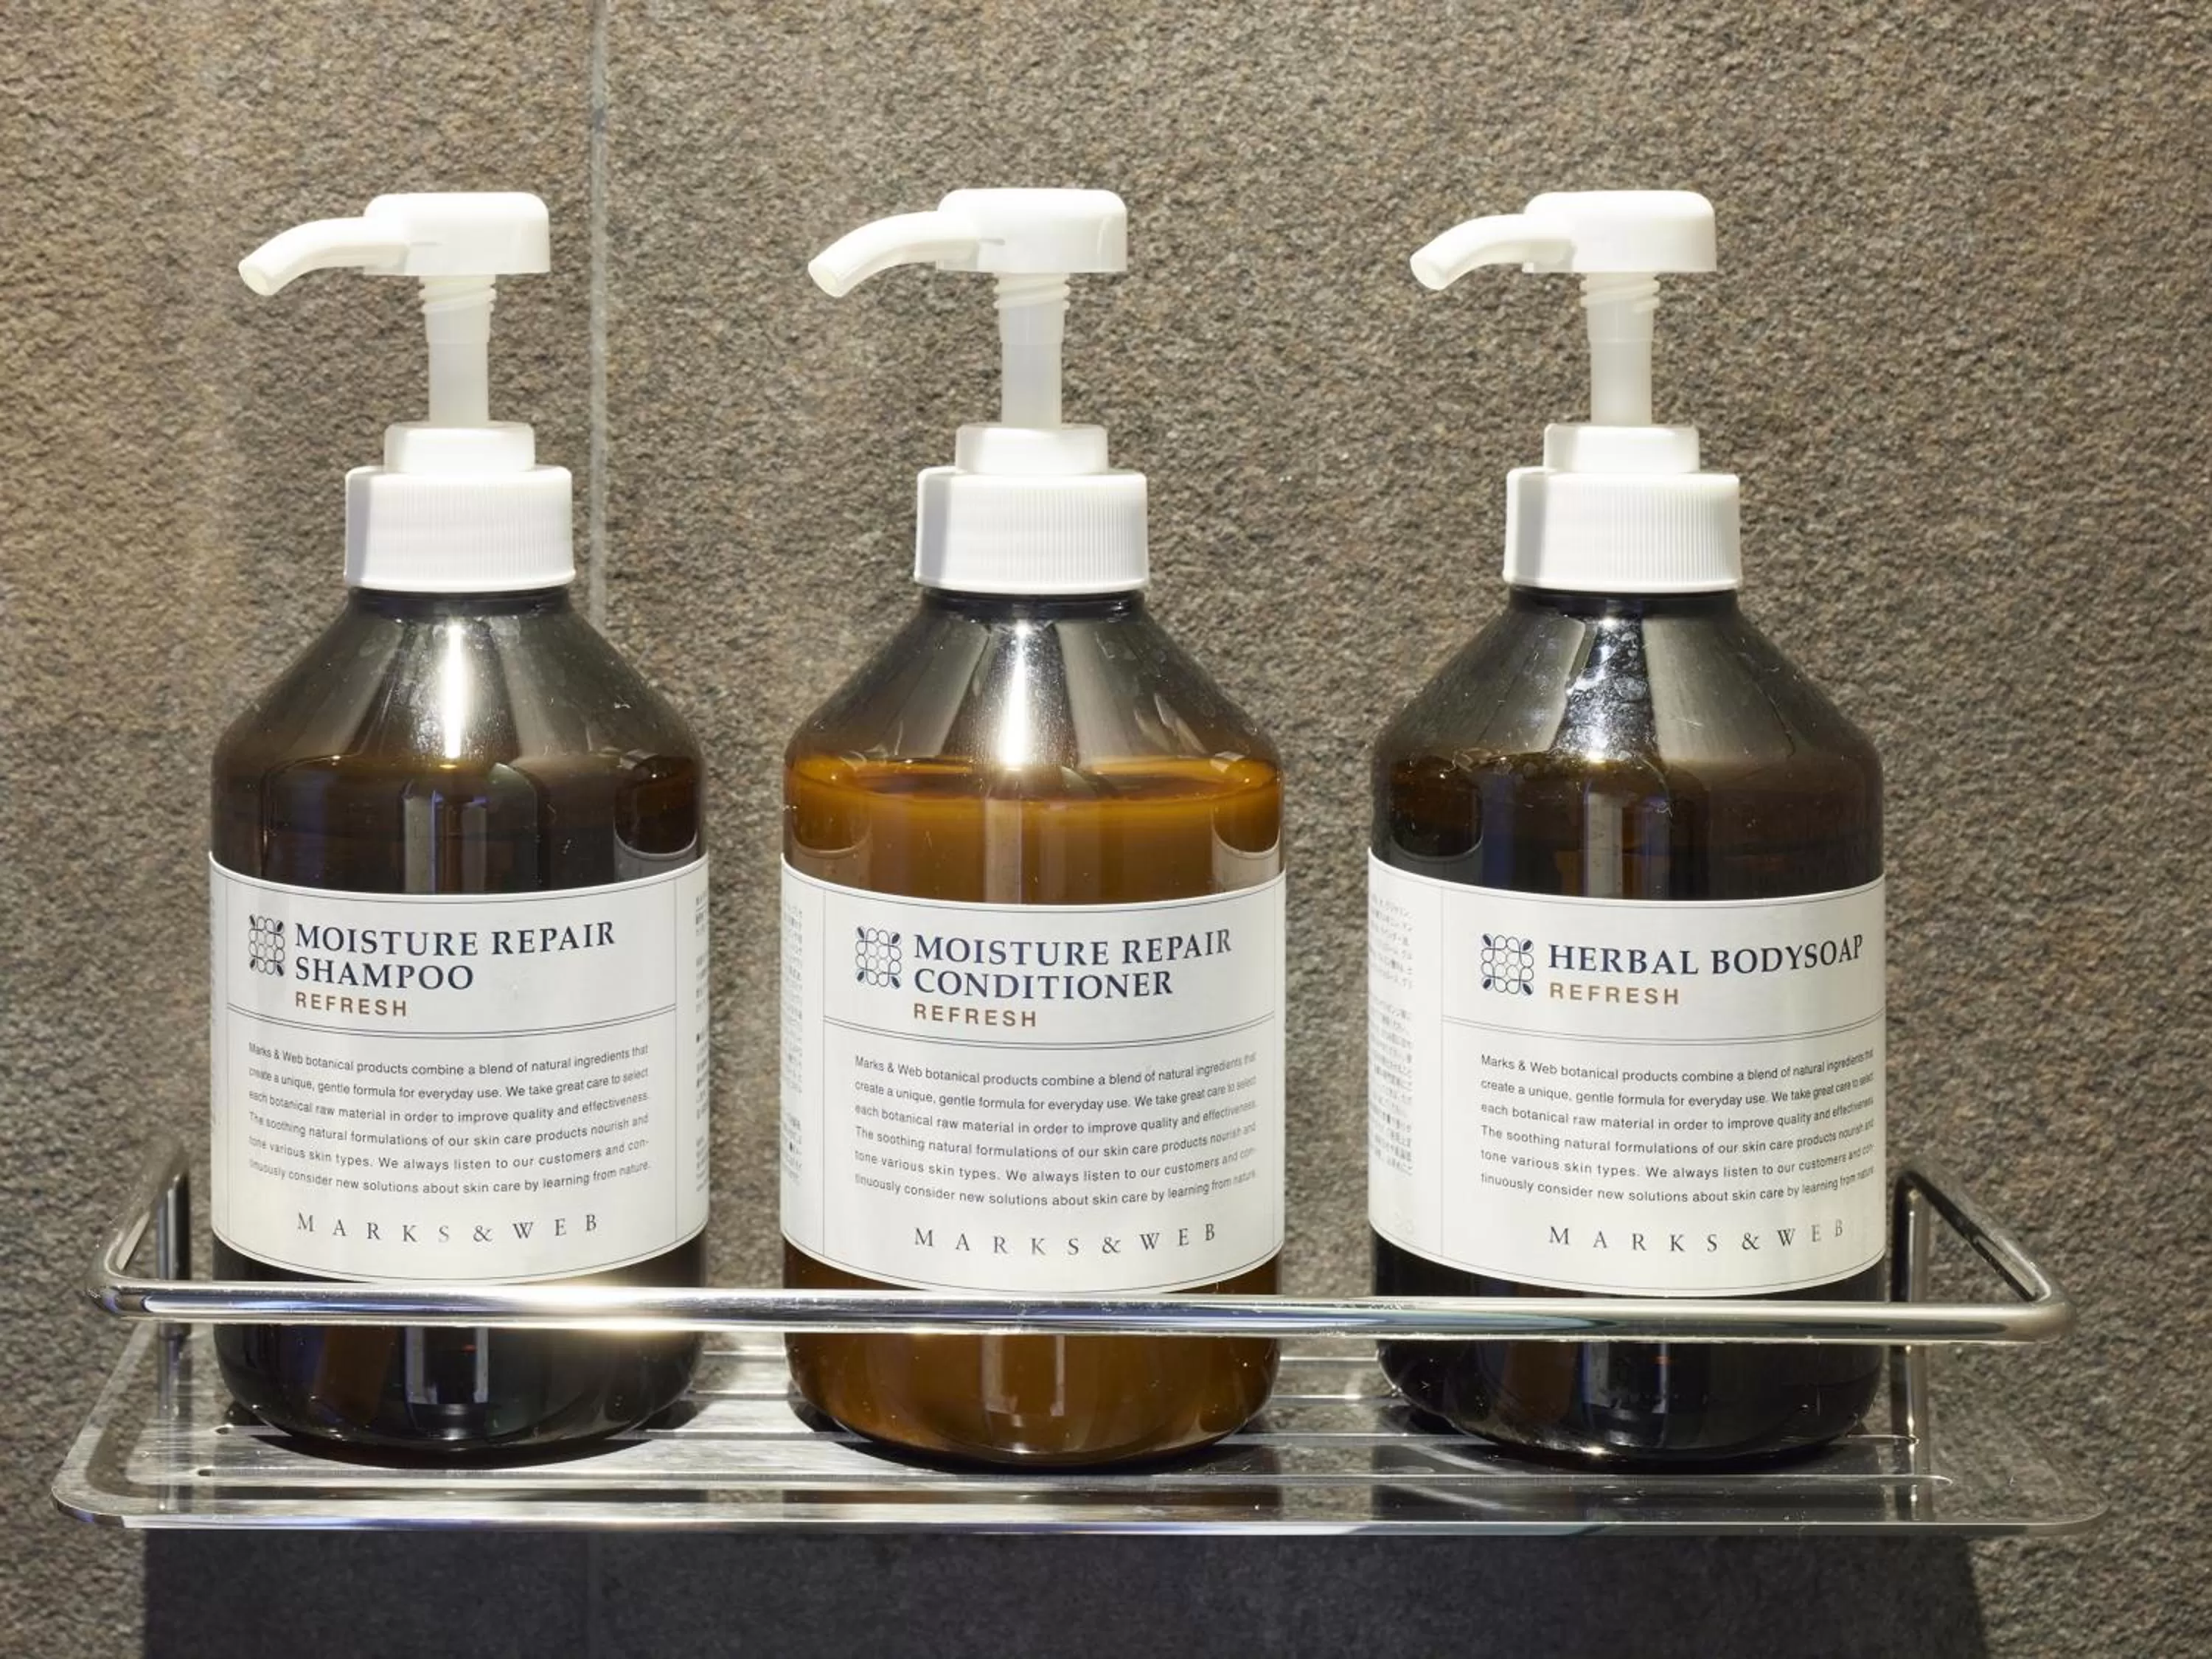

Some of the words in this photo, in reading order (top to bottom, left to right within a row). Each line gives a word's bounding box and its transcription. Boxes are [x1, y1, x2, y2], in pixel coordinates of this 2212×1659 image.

[295, 923, 478, 958] MOISTURE
[491, 922, 614, 955] REPAIR
[914, 934, 1109, 966] MOISTURE
[1122, 929, 1231, 964] REPAIR
[1548, 944, 1699, 975] HERBAL
[1711, 934, 1863, 974] BODYSOAP
[296, 955, 476, 990] SHAMPOO
[914, 968, 1172, 1000] CONDITIONER
[296, 991, 406, 1017] REFRESH
[1550, 982, 1678, 1005] REFRESH
[914, 1003, 1035, 1026] REFRESH
[305, 1055, 354, 1071] botanical
[356, 1062, 408, 1074] products
[410, 1064, 464, 1075] combine
[467, 1066, 476, 1075] a
[479, 1062, 513, 1074] blend
[516, 1062, 528, 1073] of
[532, 1057, 571, 1071] natural
[897, 1063, 922, 1077] Web
[925, 1068, 980, 1083] botanical
[983, 1074, 1038, 1086] products
[1040, 1075, 1095, 1086] combine
[1099, 1076, 1106, 1085] a
[1109, 1073, 1141, 1085] blend
[1144, 1070, 1155, 1082] of
[1158, 1066, 1194, 1081] natural
[1481, 1054, 1514, 1069] Marks
[1530, 1062, 1557, 1075] Web
[1562, 1065, 1618, 1080] botanical
[1623, 1070, 1678, 1082] products
[1682, 1071, 1733, 1082] combine
[1747, 1068, 1778, 1080] blend
[317, 1082, 350, 1094] gentle
[353, 1084, 396, 1097] formula
[399, 1086, 415, 1098] for
[417, 1088, 473, 1101] everyday
[505, 1085, 526, 1097] We
[529, 1085, 553, 1096] take
[555, 1079, 585, 1095] great
[586, 1077, 609, 1089] care
[1481, 1079, 1515, 1093] create
[1576, 1092, 1614, 1104] gentle
[1618, 1092, 1665, 1106] formula
[1669, 1094, 1685, 1106] for
[1688, 1093, 1742, 1108] everyday
[316, 1105, 335, 1116] raw
[338, 1108, 386, 1121] material
[390, 1110, 400, 1121] in
[403, 1111, 439, 1122] order
[442, 1113, 454, 1122] to
[458, 1112, 509, 1124] improve
[512, 1107, 554, 1122] quality
[557, 1103, 579, 1116] and
[938, 1095, 975, 1107] gentle
[978, 1096, 1026, 1110] formula
[1029, 1098, 1046, 1110] for
[1048, 1098, 1104, 1112] everyday
[1134, 1095, 1153, 1107] We
[1155, 1093, 1178, 1105] take
[881, 1108, 933, 1127] botanical
[936, 1119, 959, 1129] raw
[962, 1121, 1014, 1133] material
[1018, 1121, 1030, 1133] in
[1033, 1123, 1068, 1134] order
[1071, 1123, 1085, 1134] to
[1088, 1121, 1137, 1135] improve
[1141, 1117, 1179, 1132] quality
[1481, 1104, 1508, 1116] each
[1512, 1106, 1570, 1124] botanical
[1573, 1116, 1596, 1127] raw
[1601, 1118, 1654, 1130] material
[1658, 1119, 1670, 1130] in
[1673, 1119, 1708, 1130] order
[1711, 1120, 1724, 1130] to
[1728, 1118, 1774, 1131] improve
[309, 1126, 347, 1141] natural
[350, 1130, 428, 1146] formulations
[431, 1135, 445, 1147] of
[448, 1137, 469, 1147] our
[473, 1135, 500, 1146] skin
[504, 1133, 532, 1144] care
[535, 1127, 588, 1144] products
[877, 1133, 925, 1151] soothing
[928, 1141, 973, 1155] natural
[975, 1144, 1058, 1158] formulations
[1062, 1147, 1074, 1158] of
[1077, 1148, 1099, 1158] our
[1103, 1144, 1129, 1157] skin
[1132, 1144, 1158, 1155] care
[1481, 1124, 1503, 1139] The
[1507, 1132, 1561, 1149] soothing
[1564, 1138, 1610, 1151] natural
[1615, 1141, 1698, 1154] formulations
[1702, 1142, 1714, 1154] of
[1717, 1144, 1739, 1153] our
[1742, 1140, 1766, 1152] skin
[309, 1147, 332, 1162] skin
[378, 1157, 399, 1169] We
[403, 1158, 449, 1172] always
[454, 1159, 490, 1170] listen
[495, 1159, 508, 1169] to
[512, 1157, 534, 1167] our
[538, 1148, 602, 1166] customers
[880, 1158, 925, 1173] various
[928, 1164, 955, 1176] skin
[1006, 1169, 1027, 1181] We
[1032, 1171, 1079, 1184] always
[1083, 1170, 1120, 1181] listen
[1124, 1169, 1136, 1179] to
[1141, 1168, 1161, 1178] our
[1511, 1156, 1559, 1171] various
[1564, 1161, 1592, 1174] skin
[1646, 1166, 1667, 1178] We
[1672, 1167, 1719, 1180] always
[1724, 1166, 1759, 1178] listen
[1761, 1165, 1773, 1175] to
[336, 1179, 361, 1189] new
[363, 1180, 419, 1193] solutions
[422, 1183, 459, 1194] about
[462, 1183, 489, 1193] skin
[493, 1183, 521, 1192] care
[524, 1179, 539, 1192] by
[543, 1174, 590, 1189] learning
[593, 1169, 616, 1180] from
[1537, 1183, 1593, 1197] consider
[1598, 1189, 1624, 1200] new
[1628, 1191, 1688, 1202] solutions
[1693, 1191, 1728, 1202] about
[1732, 1189, 1756, 1200] skin
[1759, 1189, 1784, 1199] care
[904, 1185, 956, 1200] consider
[959, 1192, 985, 1203] new
[989, 1193, 1048, 1206] solutions
[1052, 1194, 1089, 1206] about
[1092, 1193, 1118, 1205] skin
[1121, 1192, 1148, 1203] care
[1151, 1189, 1165, 1202] by
